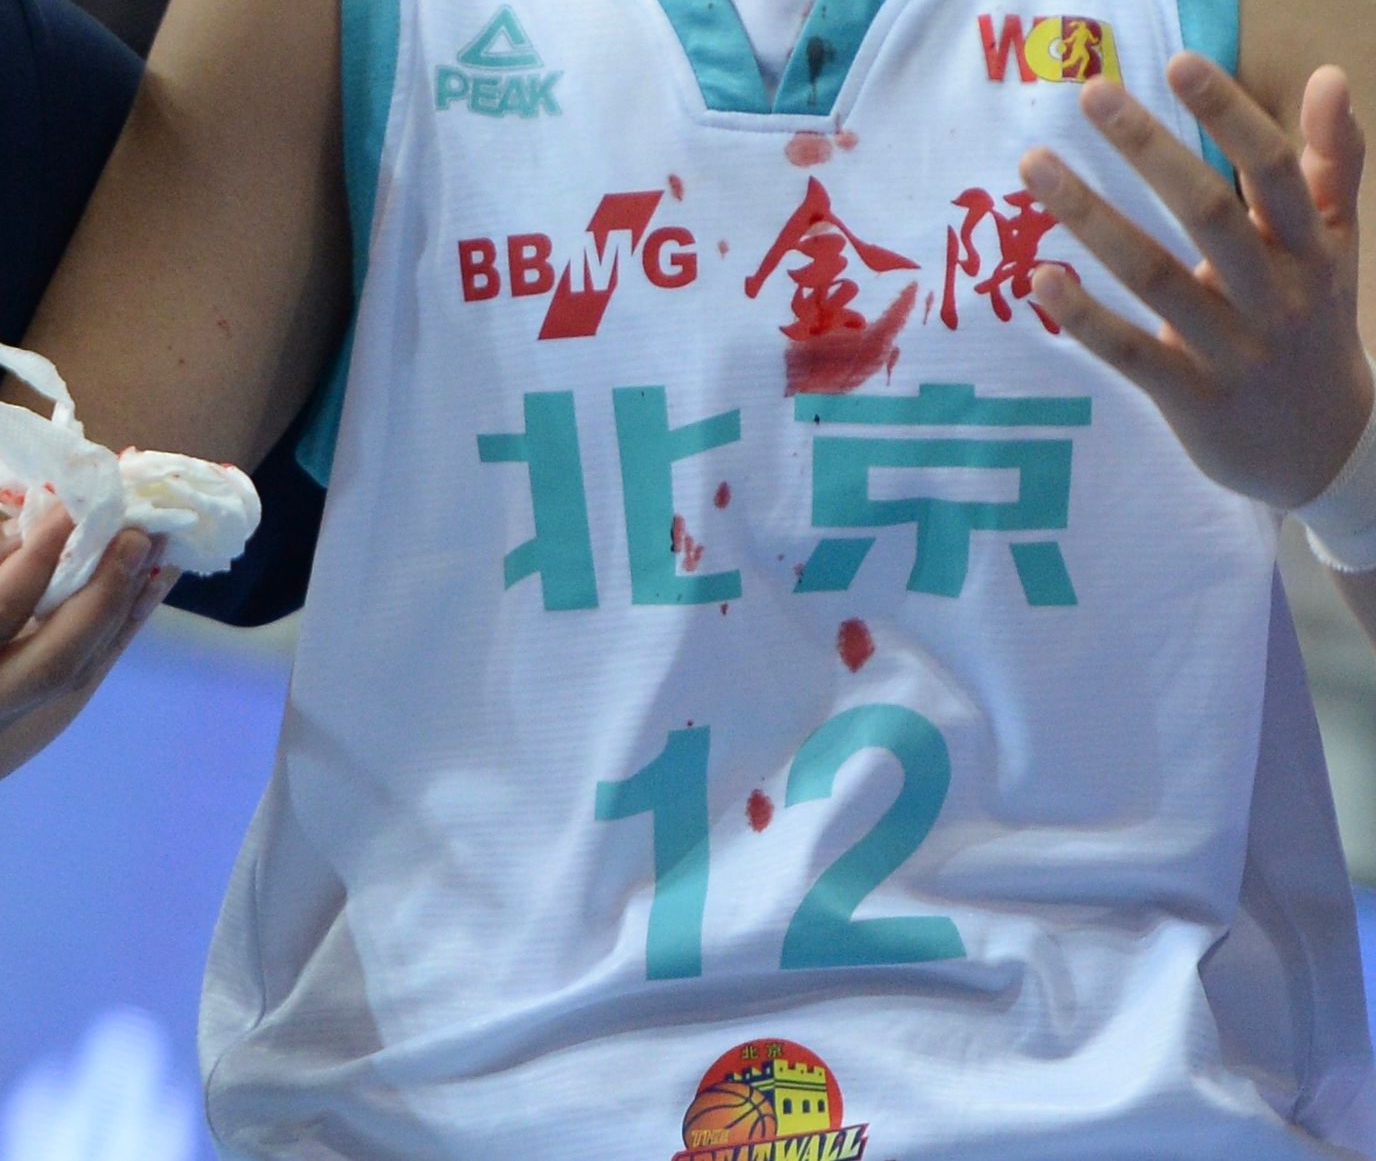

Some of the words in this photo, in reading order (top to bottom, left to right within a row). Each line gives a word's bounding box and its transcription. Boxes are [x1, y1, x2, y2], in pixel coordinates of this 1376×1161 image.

[434, 64, 564, 118] PEAK
[458, 220, 699, 309] BBMG
[476, 382, 1092, 612] 北京
[595, 703, 967, 980] 12
